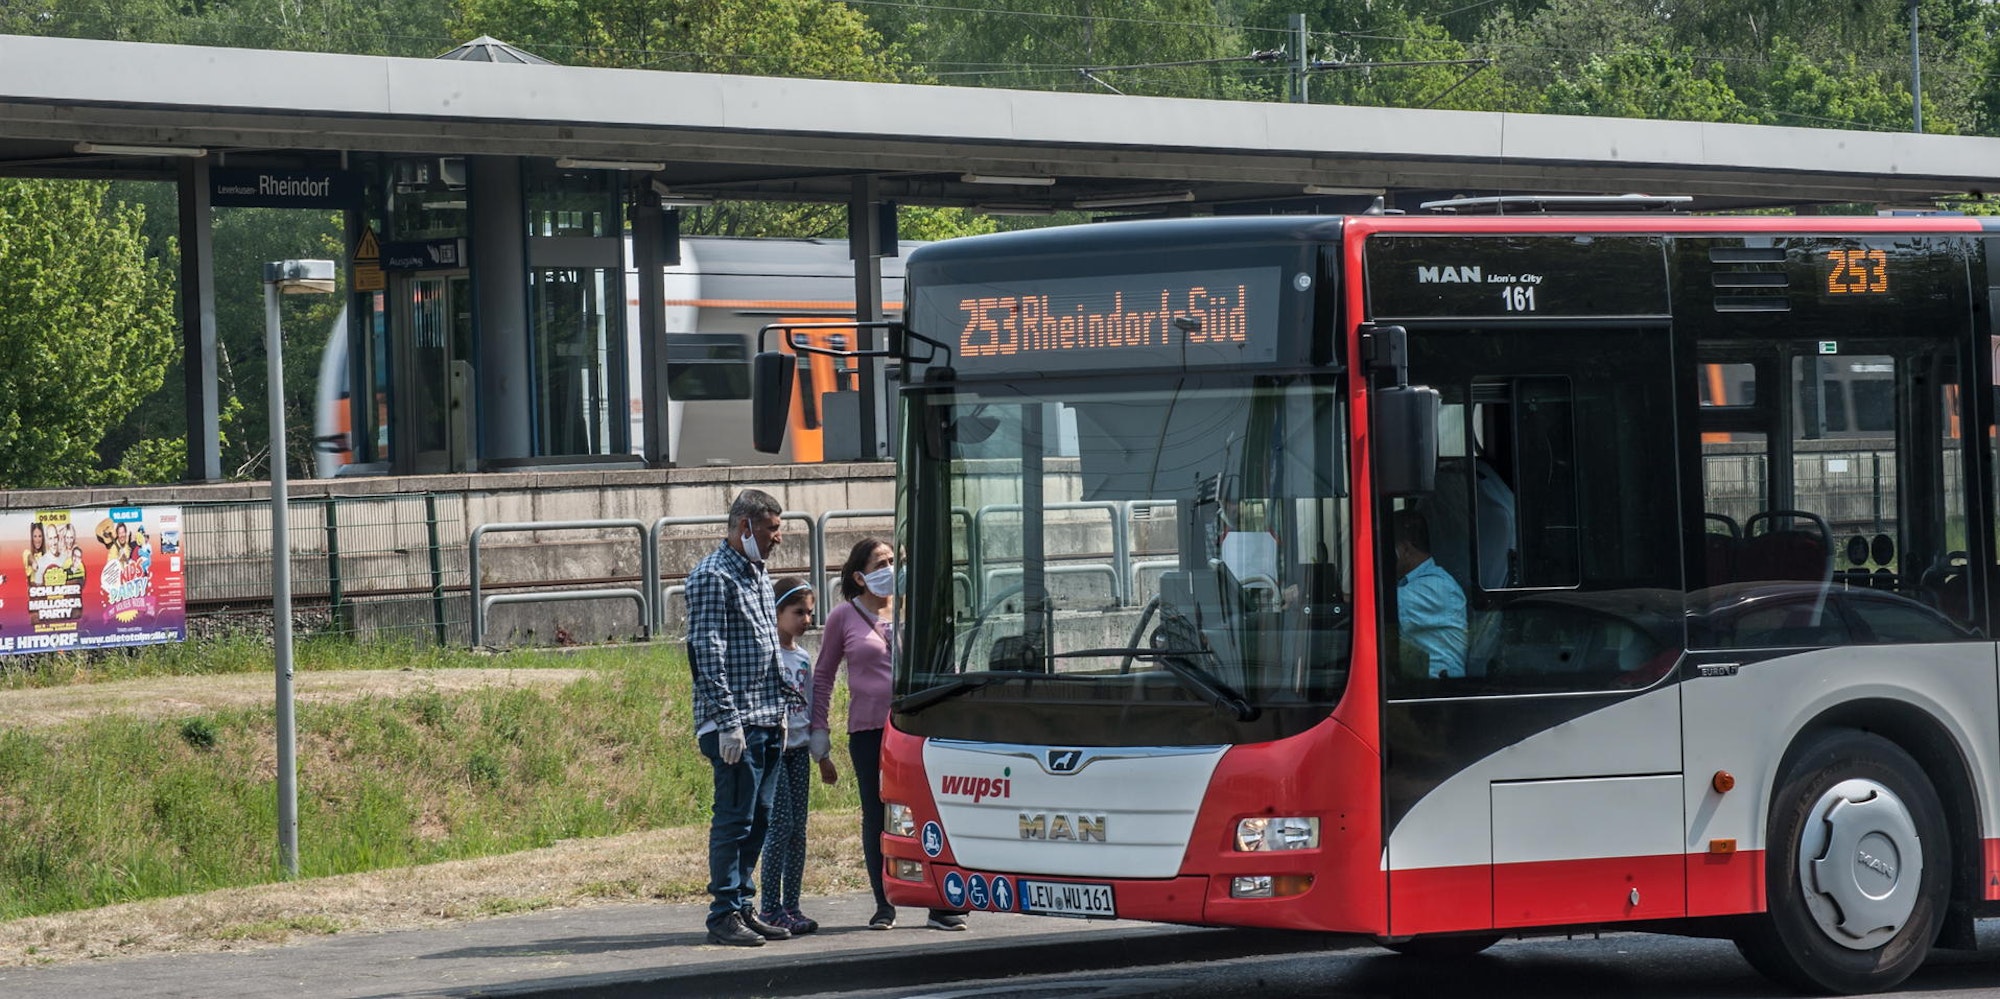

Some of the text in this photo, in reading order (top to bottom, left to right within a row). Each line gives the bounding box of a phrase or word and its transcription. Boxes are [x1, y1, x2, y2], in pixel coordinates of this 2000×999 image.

[259, 174, 330, 198] Rheindorf
[1418, 266, 1543, 284] MAN Lion's City
[1827, 250, 1888, 293] 253
[1502, 286, 1536, 311] 161
[959, 297, 1018, 357] 253
[38, 514, 67, 522] 09.06.19
[119, 559, 143, 584] KIDS
[29, 585, 81, 597] SCHLAGER
[109, 577, 148, 604] PARTY
[29, 598, 82, 611] MALLORCA
[39, 609, 73, 620] PARTY
[17, 633, 78, 649] HITDORF
[941, 767, 1011, 803] wupsi
[1019, 813, 1106, 842] MAN
[1858, 851, 1894, 879] MAN
[1028, 885, 1112, 912] LEV WU 161
